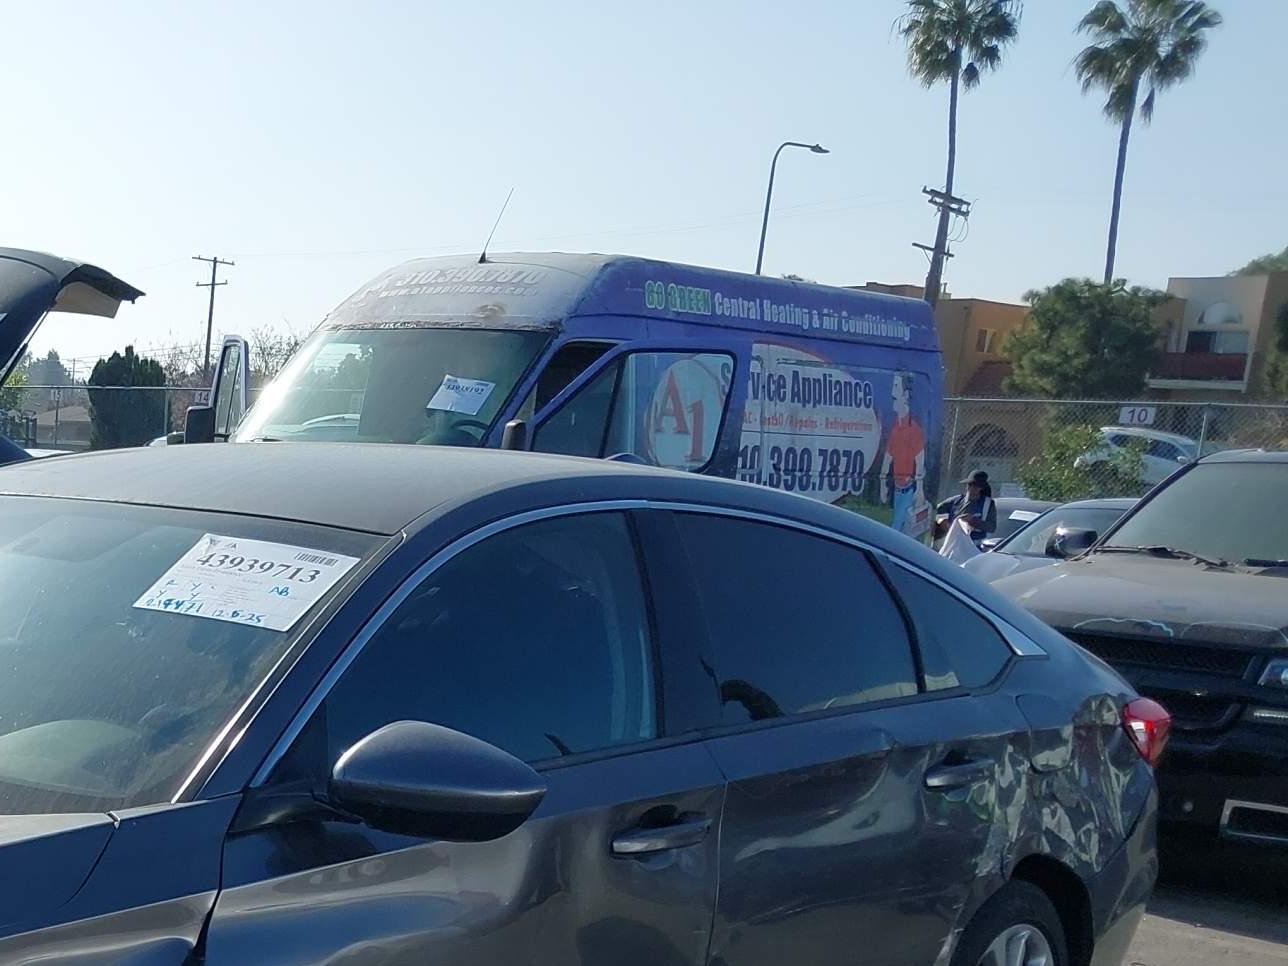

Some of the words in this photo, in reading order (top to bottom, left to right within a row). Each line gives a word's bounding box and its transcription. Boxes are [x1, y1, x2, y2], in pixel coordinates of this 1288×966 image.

[645, 280, 665, 310] GO
[667, 283, 712, 315] GREEN
[714, 292, 760, 320] Central
[763, 299, 809, 330] Heating
[812, 309, 820, 329] &
[822, 308, 839, 332] Air
[841, 311, 911, 342] Conditioning
[791, 370, 873, 409] Appliance
[653, 367, 707, 463] A1
[1128, 408, 1148, 423] 10
[738, 445, 865, 491] 10.390.7870
[196, 553, 320, 583] 43939713
